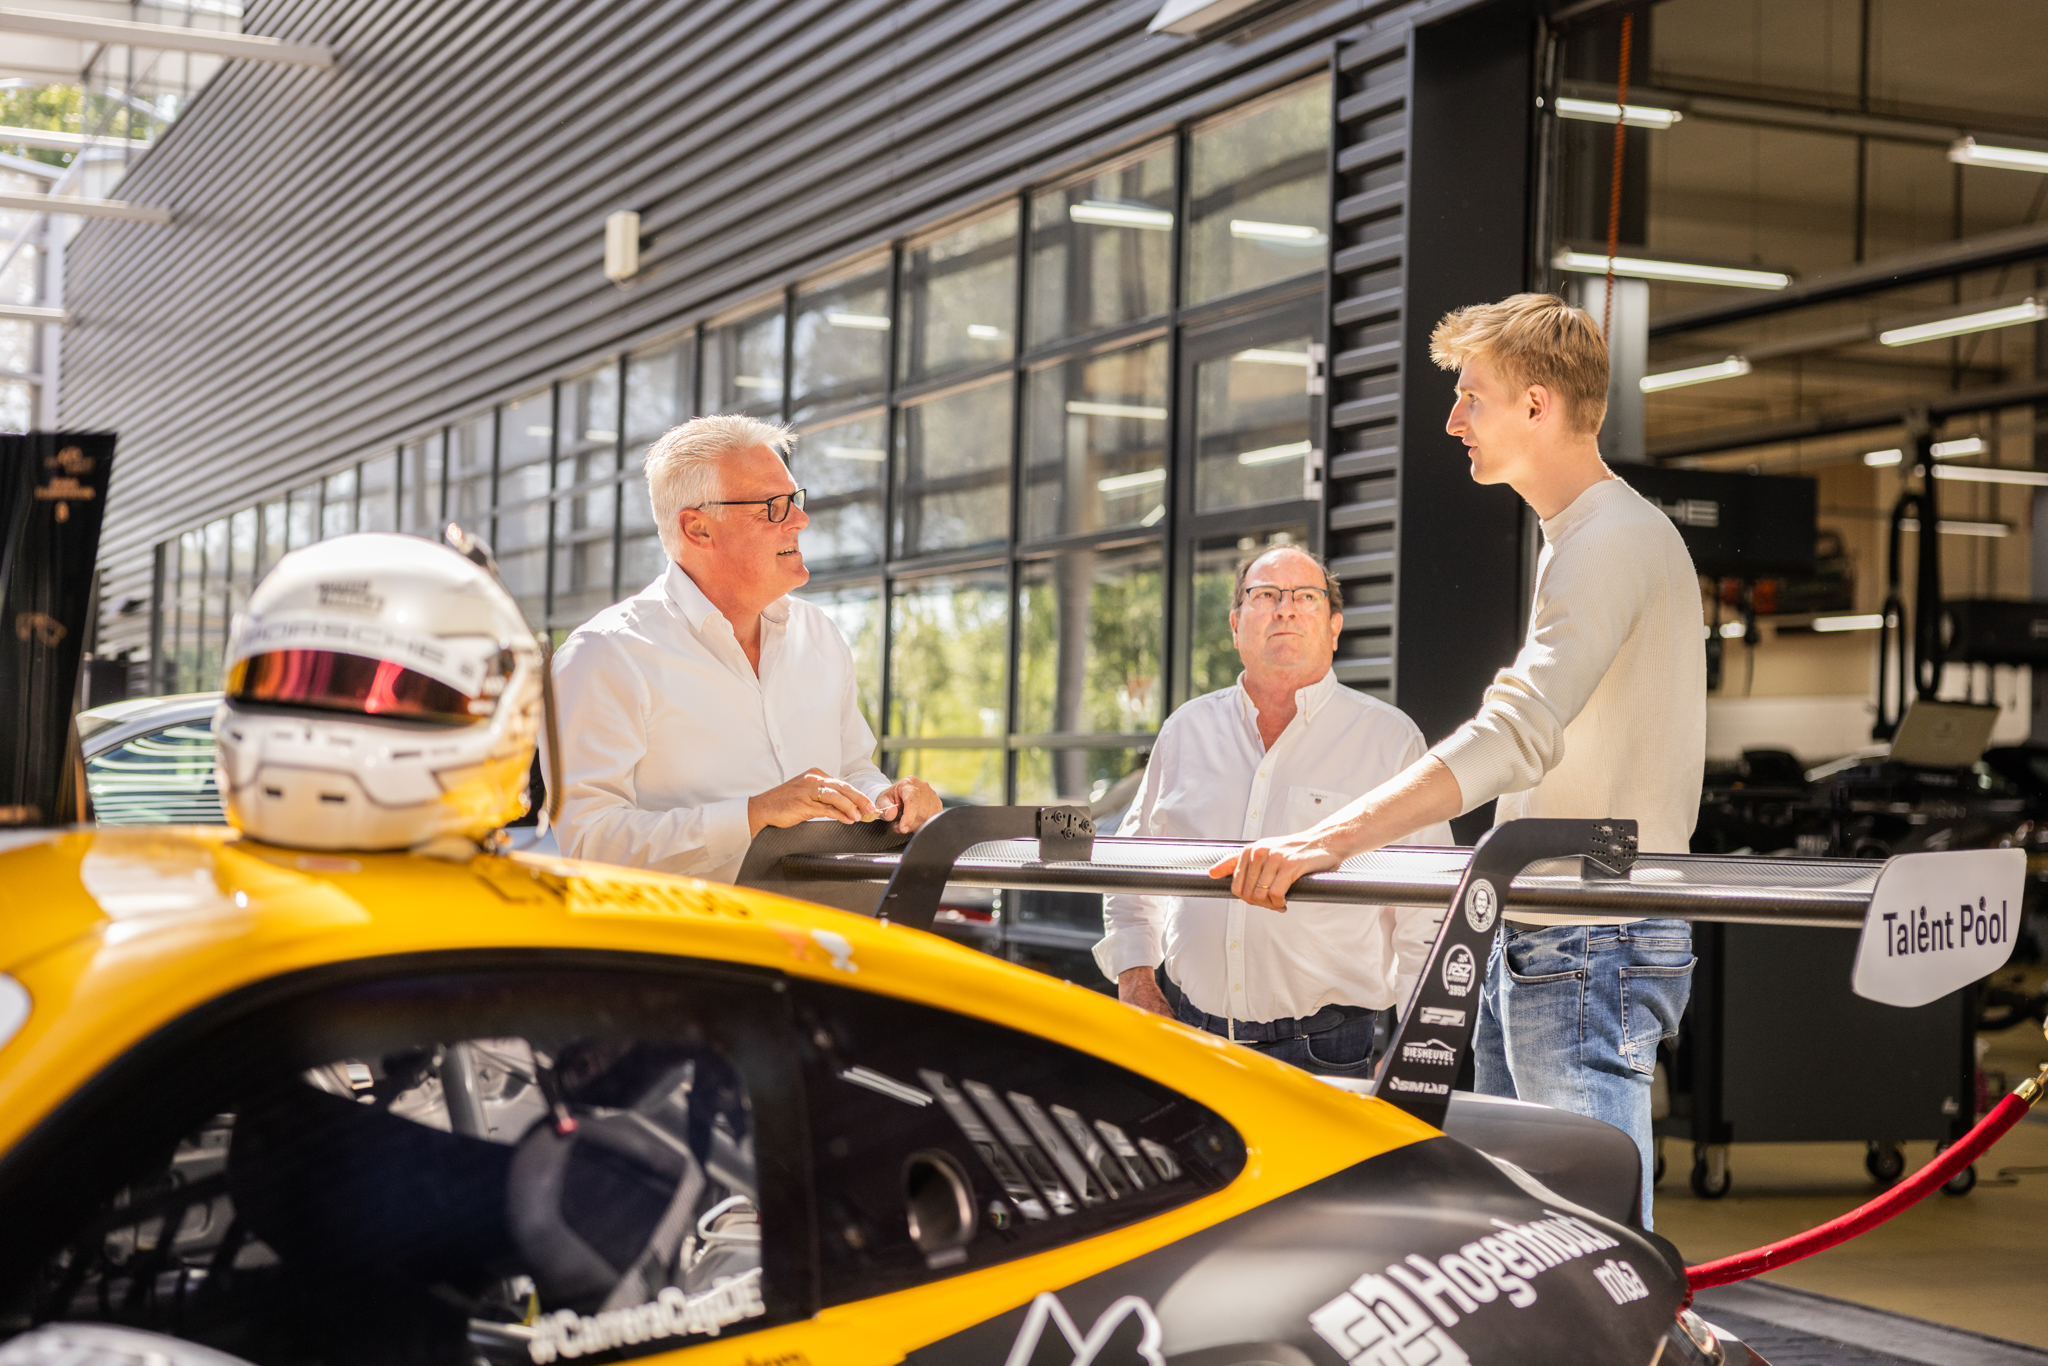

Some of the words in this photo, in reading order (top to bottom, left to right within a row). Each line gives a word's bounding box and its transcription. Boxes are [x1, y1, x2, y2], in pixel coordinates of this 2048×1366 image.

[1883, 906, 1954, 957] Talent
[1960, 896, 2007, 948] Pool
[1402, 1046, 1455, 1062] BIESHEUVEL
